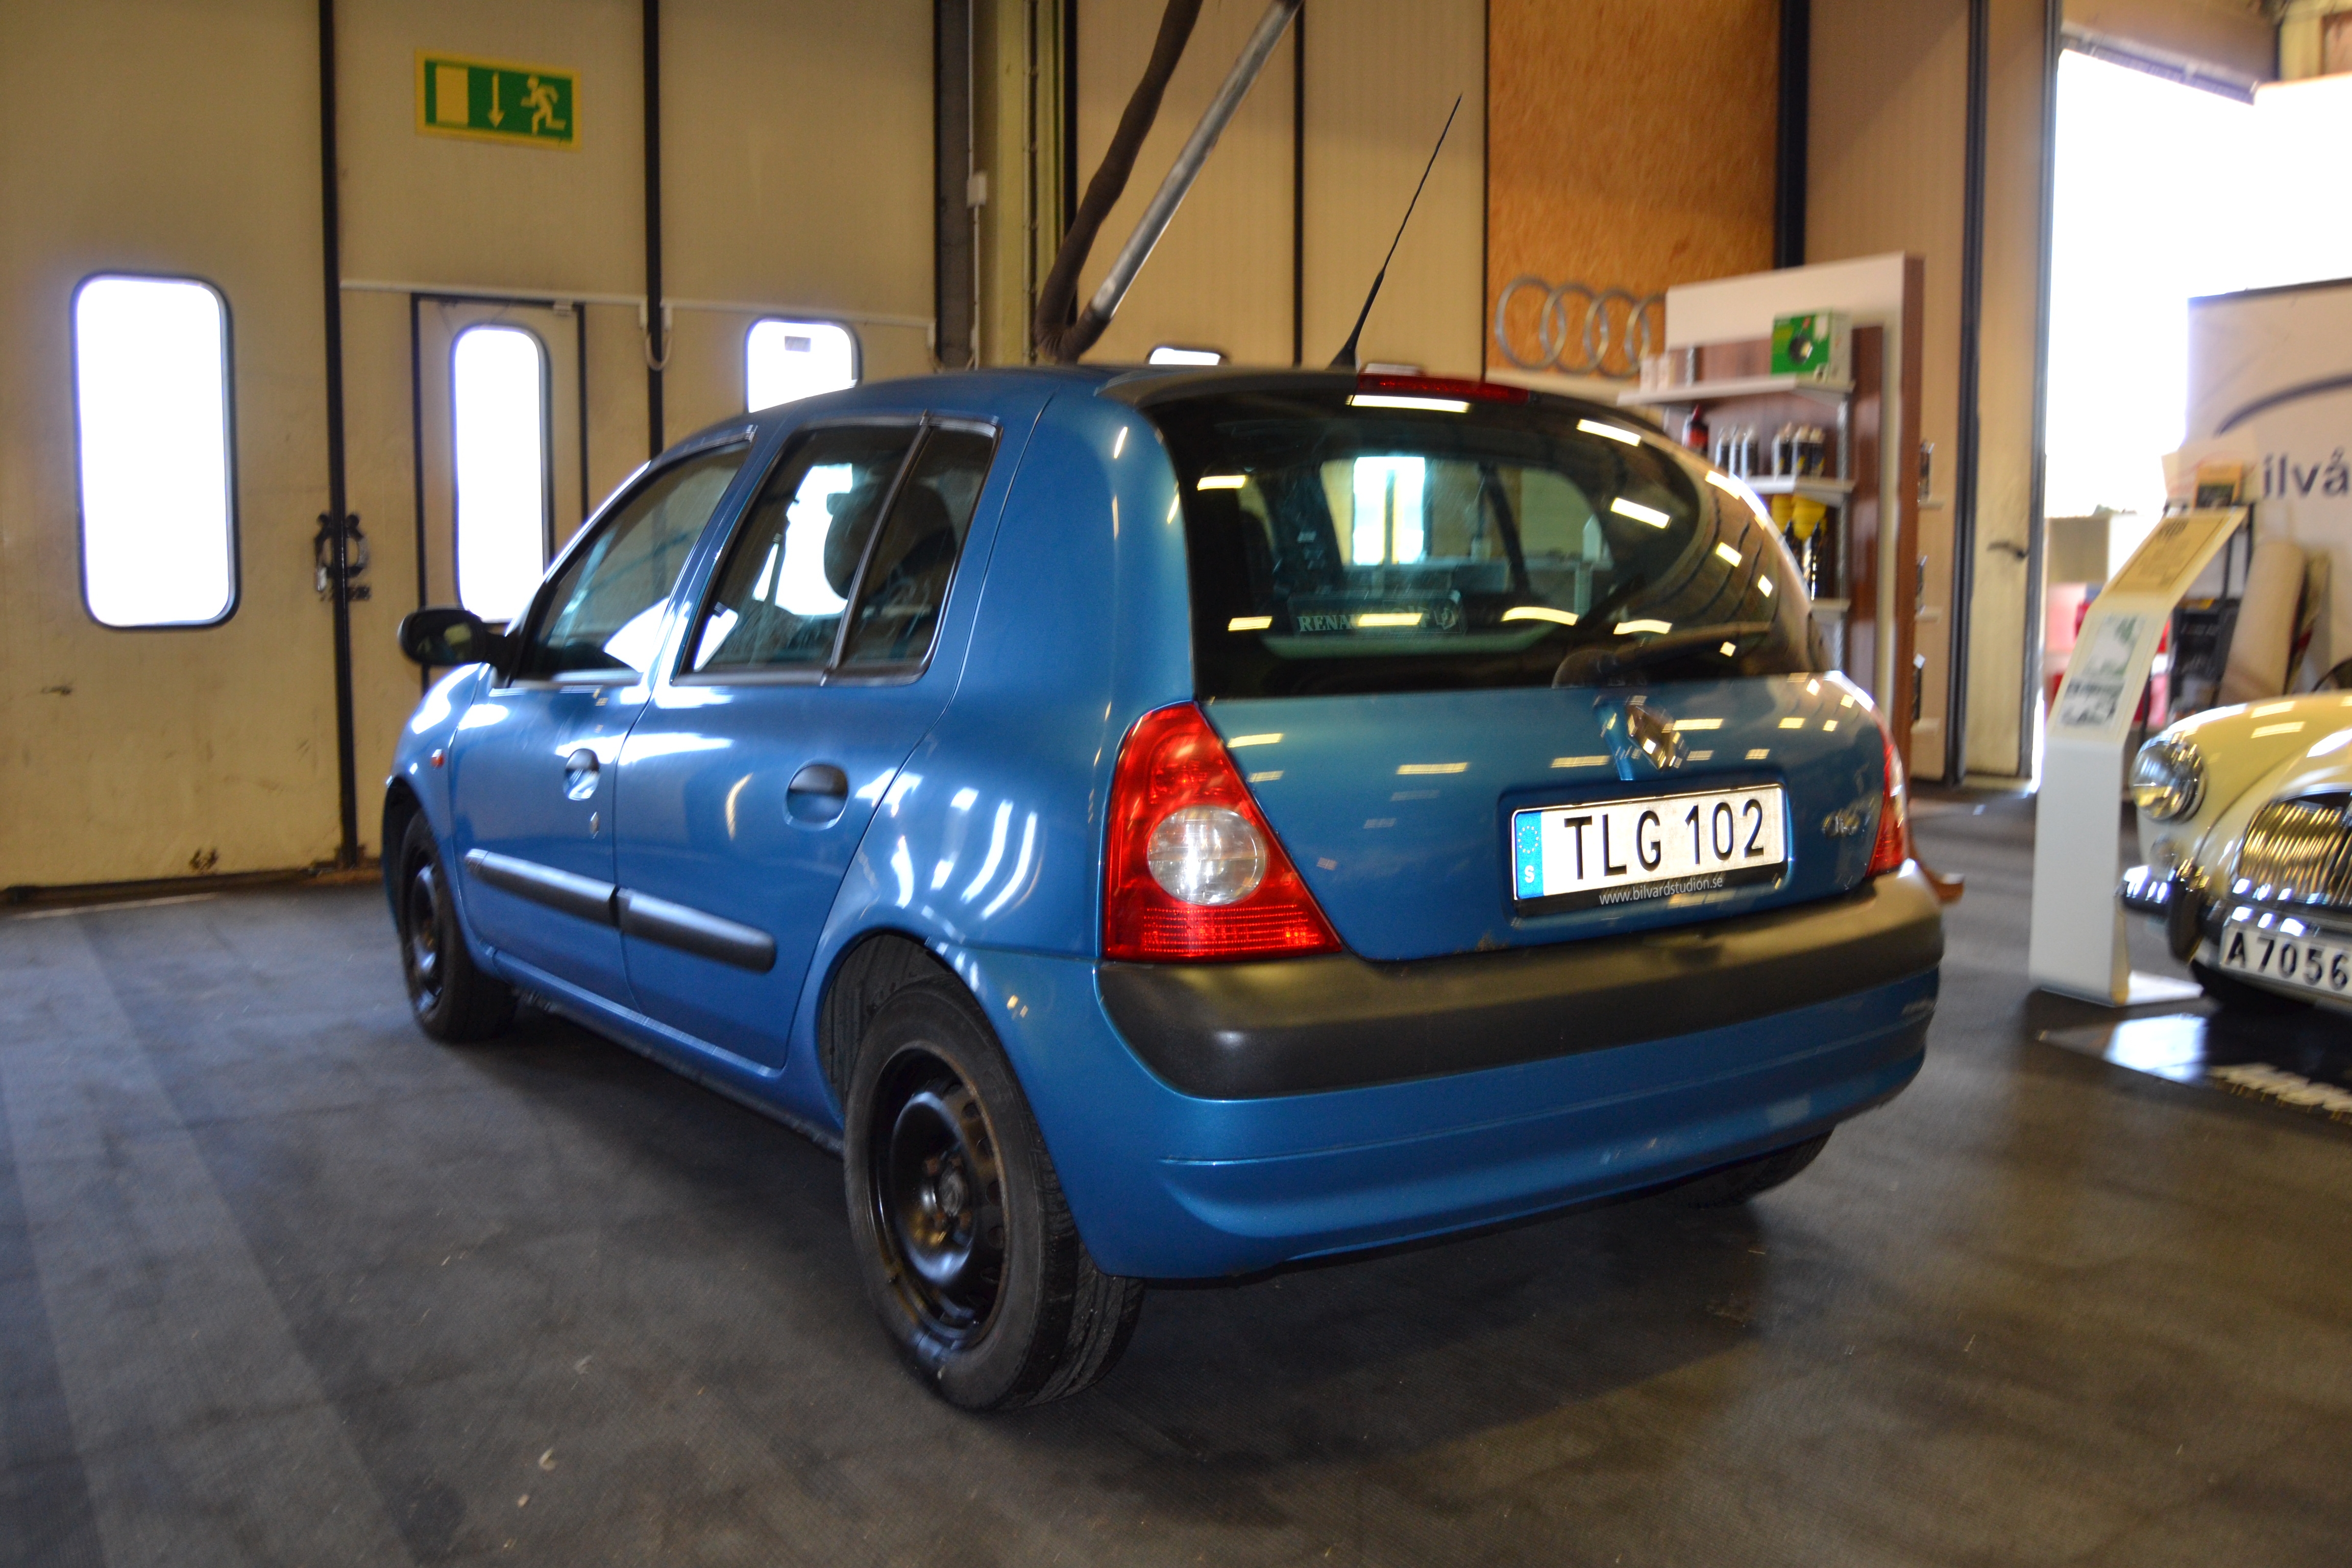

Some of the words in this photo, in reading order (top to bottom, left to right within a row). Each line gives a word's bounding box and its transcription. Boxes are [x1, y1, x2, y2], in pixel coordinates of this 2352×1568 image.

[1564, 811, 1662, 880] TLG
[1684, 799, 1765, 866] 102
[1524, 865, 1535, 883] S
[1599, 876, 1723, 905] www.bilvardstudion.se
[2224, 932, 2349, 991] A7056
